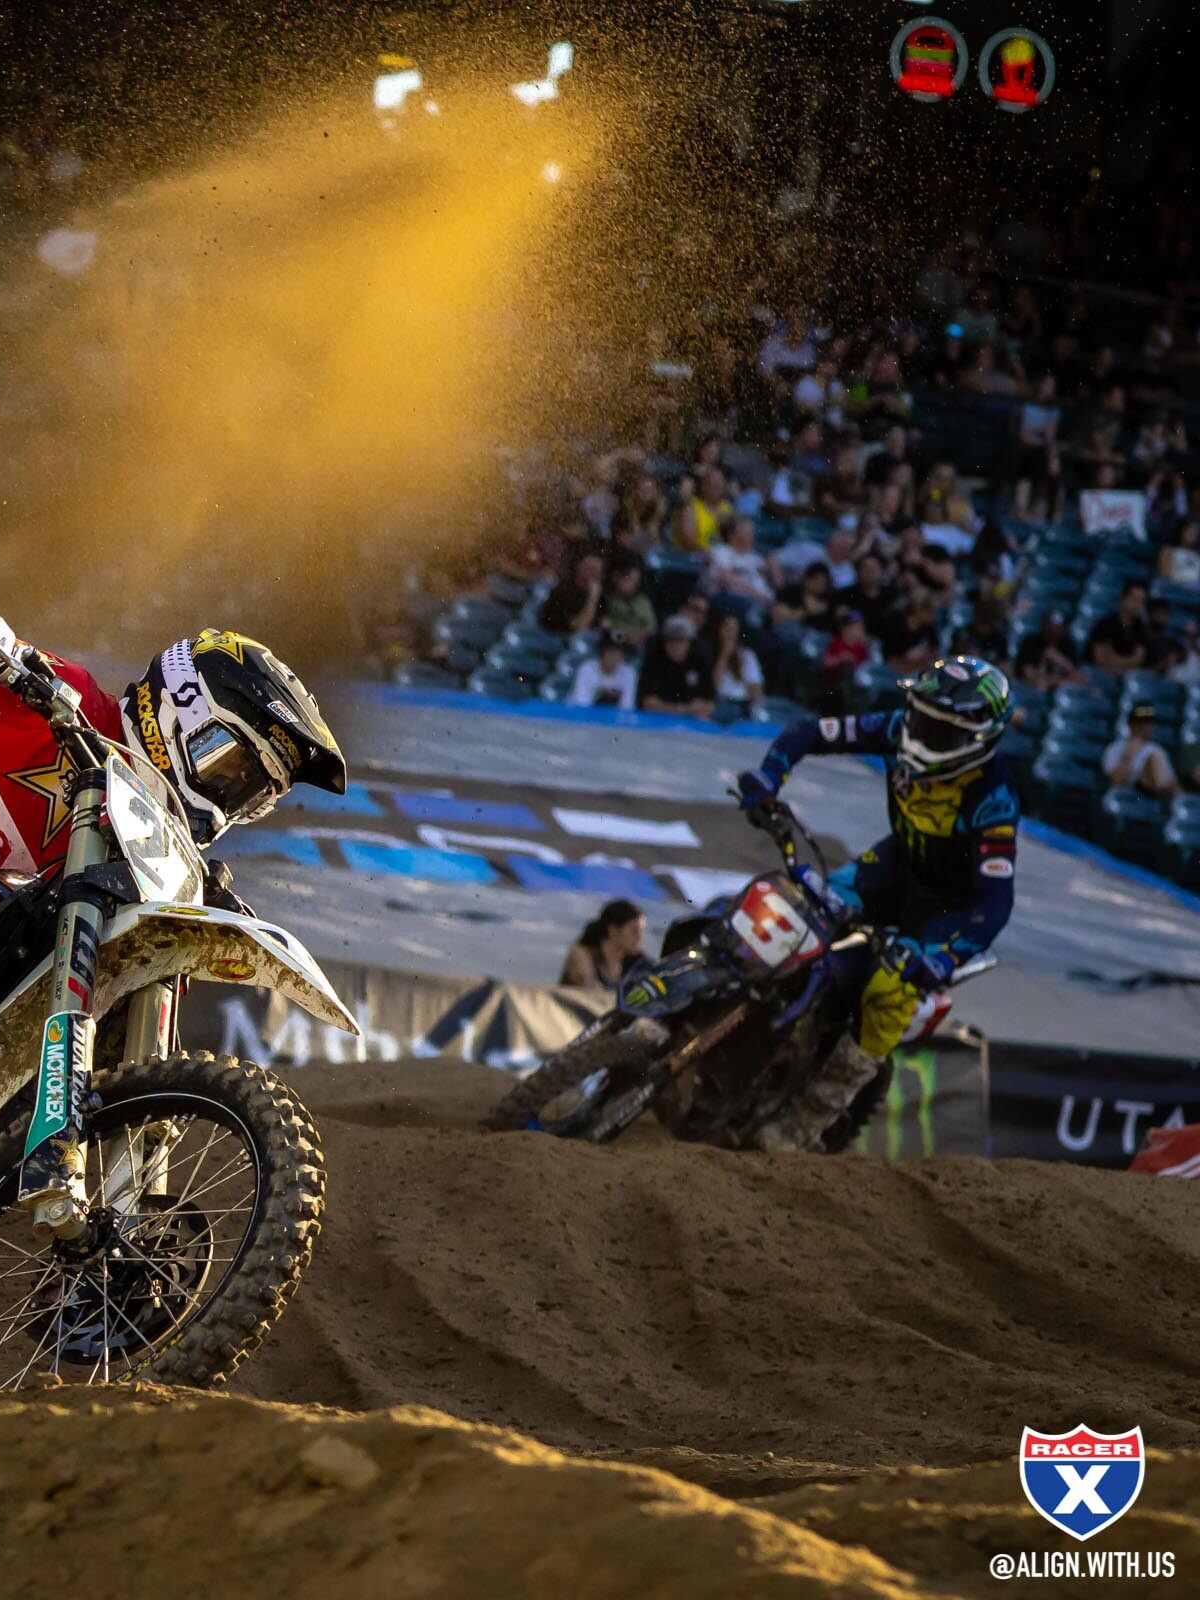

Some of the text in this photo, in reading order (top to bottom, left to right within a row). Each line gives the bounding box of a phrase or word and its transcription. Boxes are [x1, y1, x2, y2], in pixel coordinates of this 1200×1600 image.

[136, 681, 172, 771] ROCKSTAR
[45, 1043, 65, 1123] MOTOREX
[70, 1020, 86, 1131] DUNLOP
